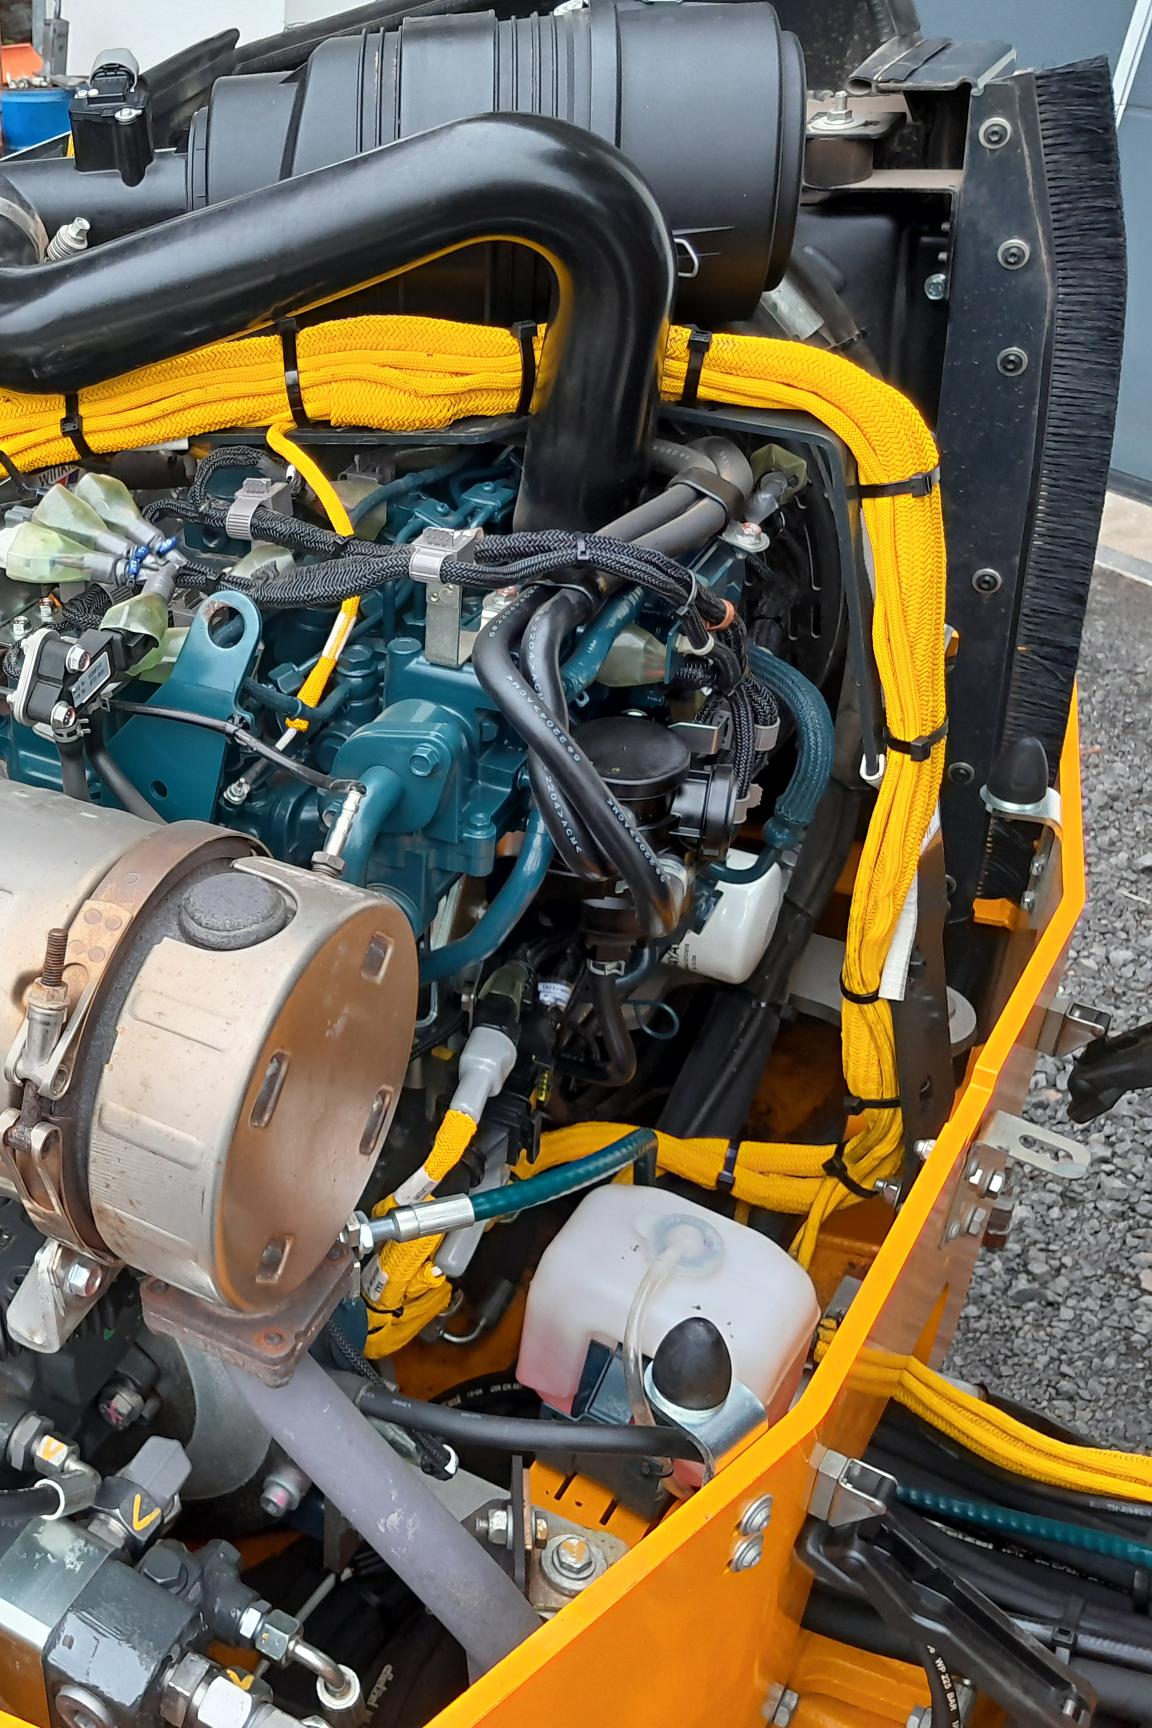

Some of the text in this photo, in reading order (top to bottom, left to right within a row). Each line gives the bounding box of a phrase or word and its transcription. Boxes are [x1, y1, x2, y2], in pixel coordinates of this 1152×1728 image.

[934, 1656, 947, 1673] WP
[940, 1673, 953, 1690] 225
[946, 1691, 958, 1712] BAR
